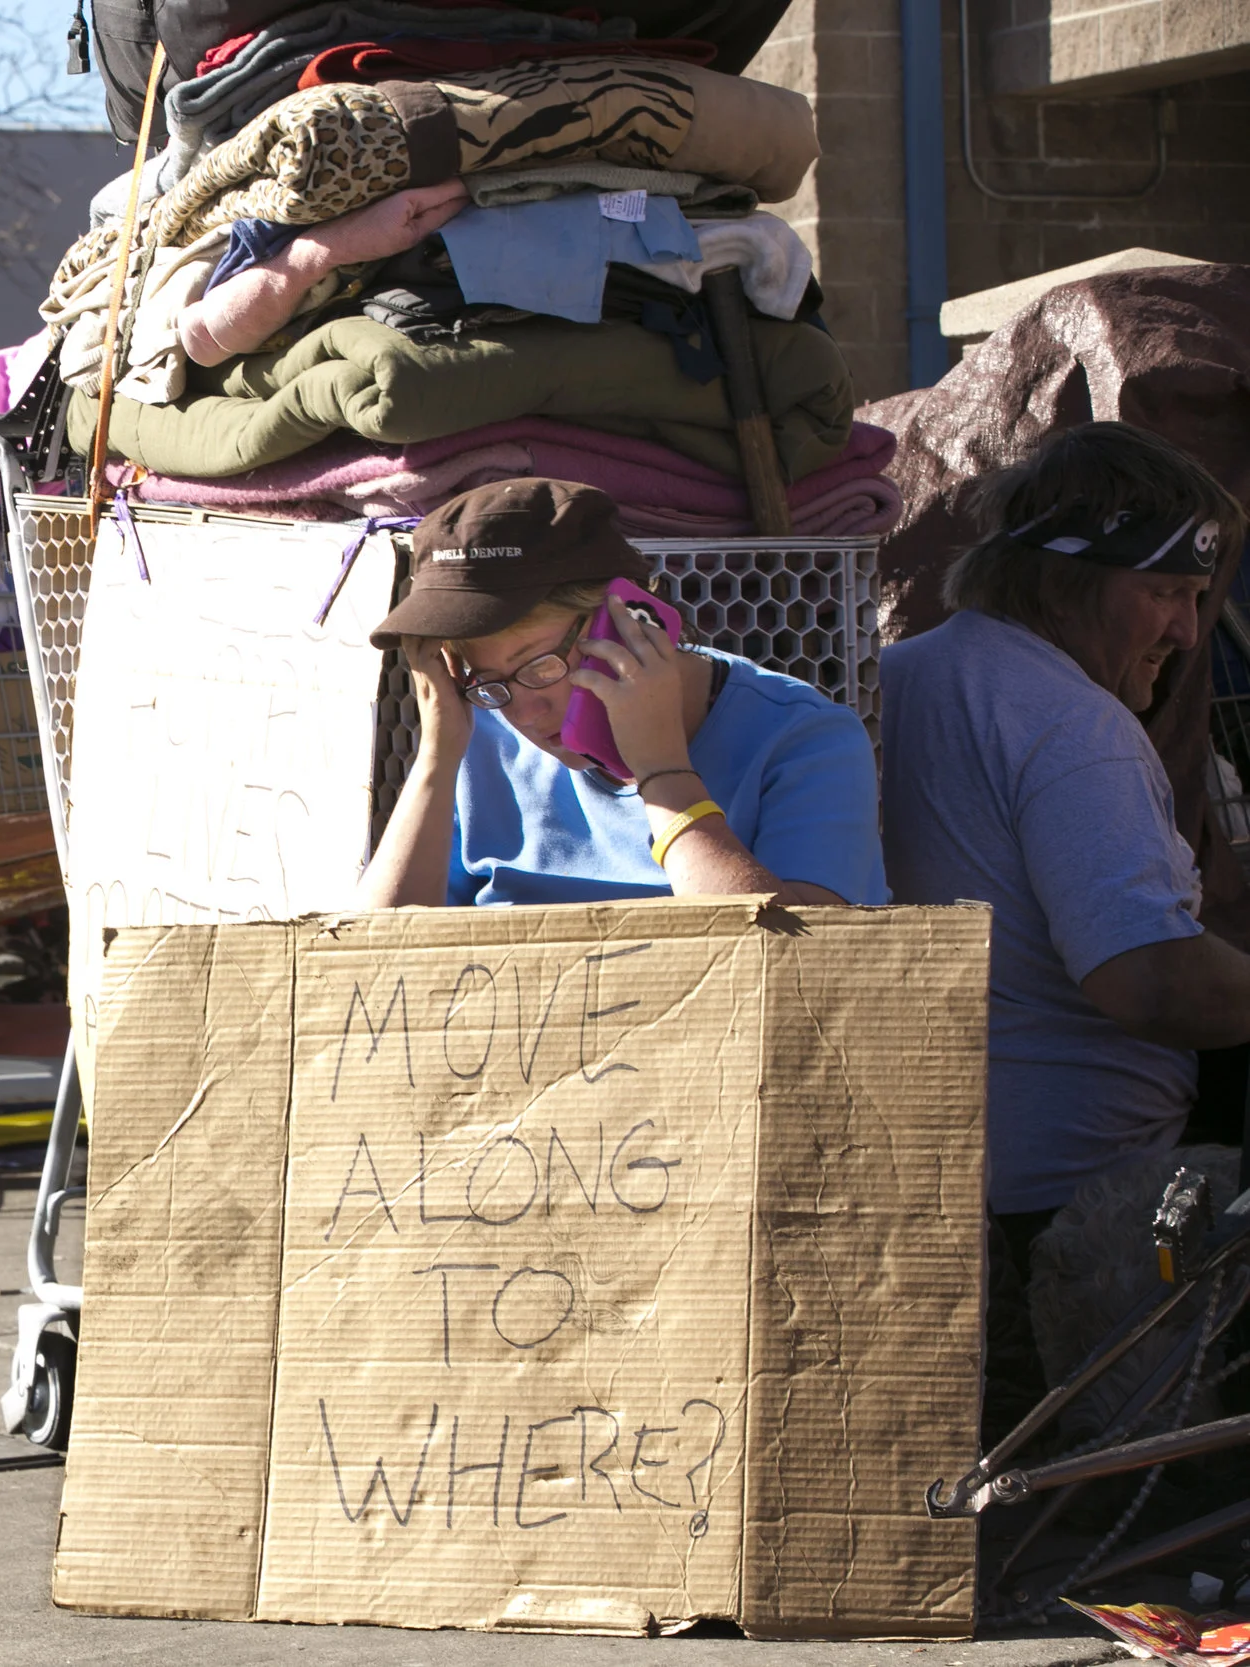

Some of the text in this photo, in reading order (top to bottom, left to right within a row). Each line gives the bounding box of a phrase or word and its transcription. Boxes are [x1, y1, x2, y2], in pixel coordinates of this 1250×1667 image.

[469, 546, 523, 559] DENVER
[332, 943, 652, 1103] MOVE
[325, 1119, 682, 1242] ALONG
[413, 1263, 576, 1368] TO
[318, 1398, 727, 1540] WHERE?
